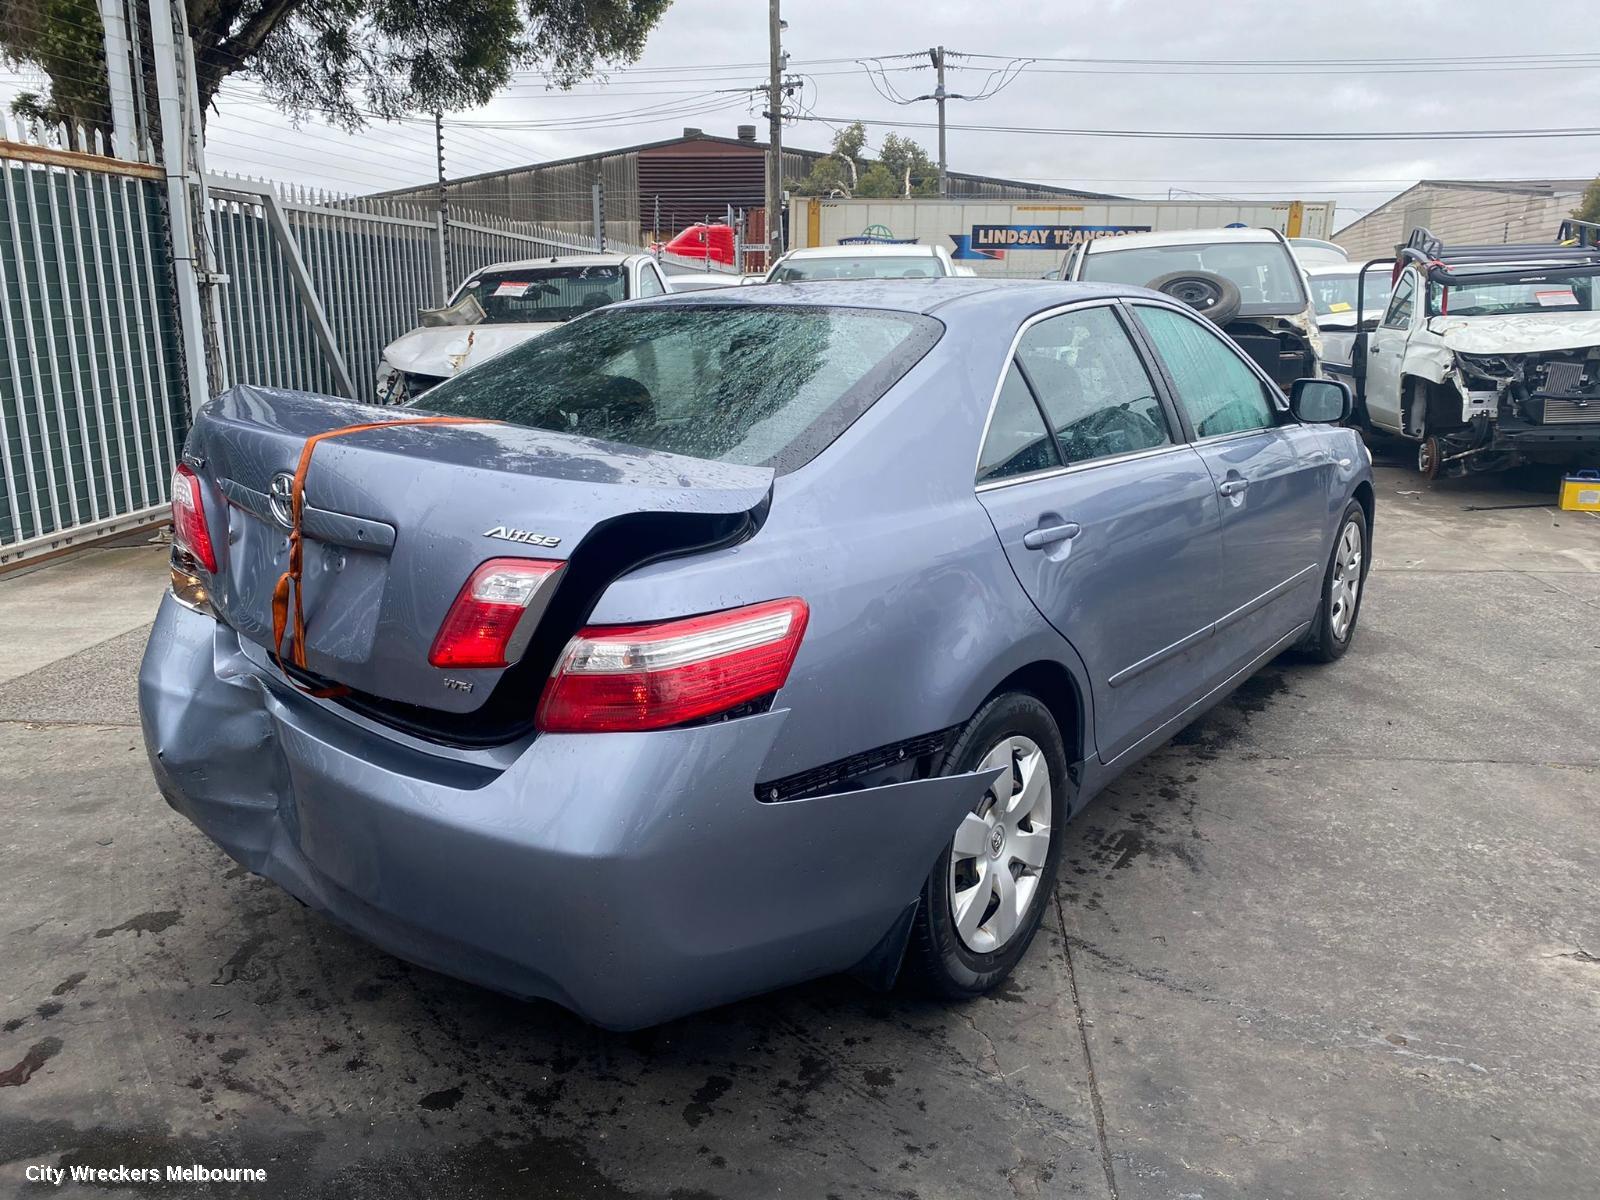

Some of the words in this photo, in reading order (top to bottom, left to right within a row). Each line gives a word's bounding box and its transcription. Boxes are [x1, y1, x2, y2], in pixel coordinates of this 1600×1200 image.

[979, 229, 1050, 244] LINDSAY
[1054, 230, 1147, 244] TRANS
[482, 526, 561, 548] Altise
